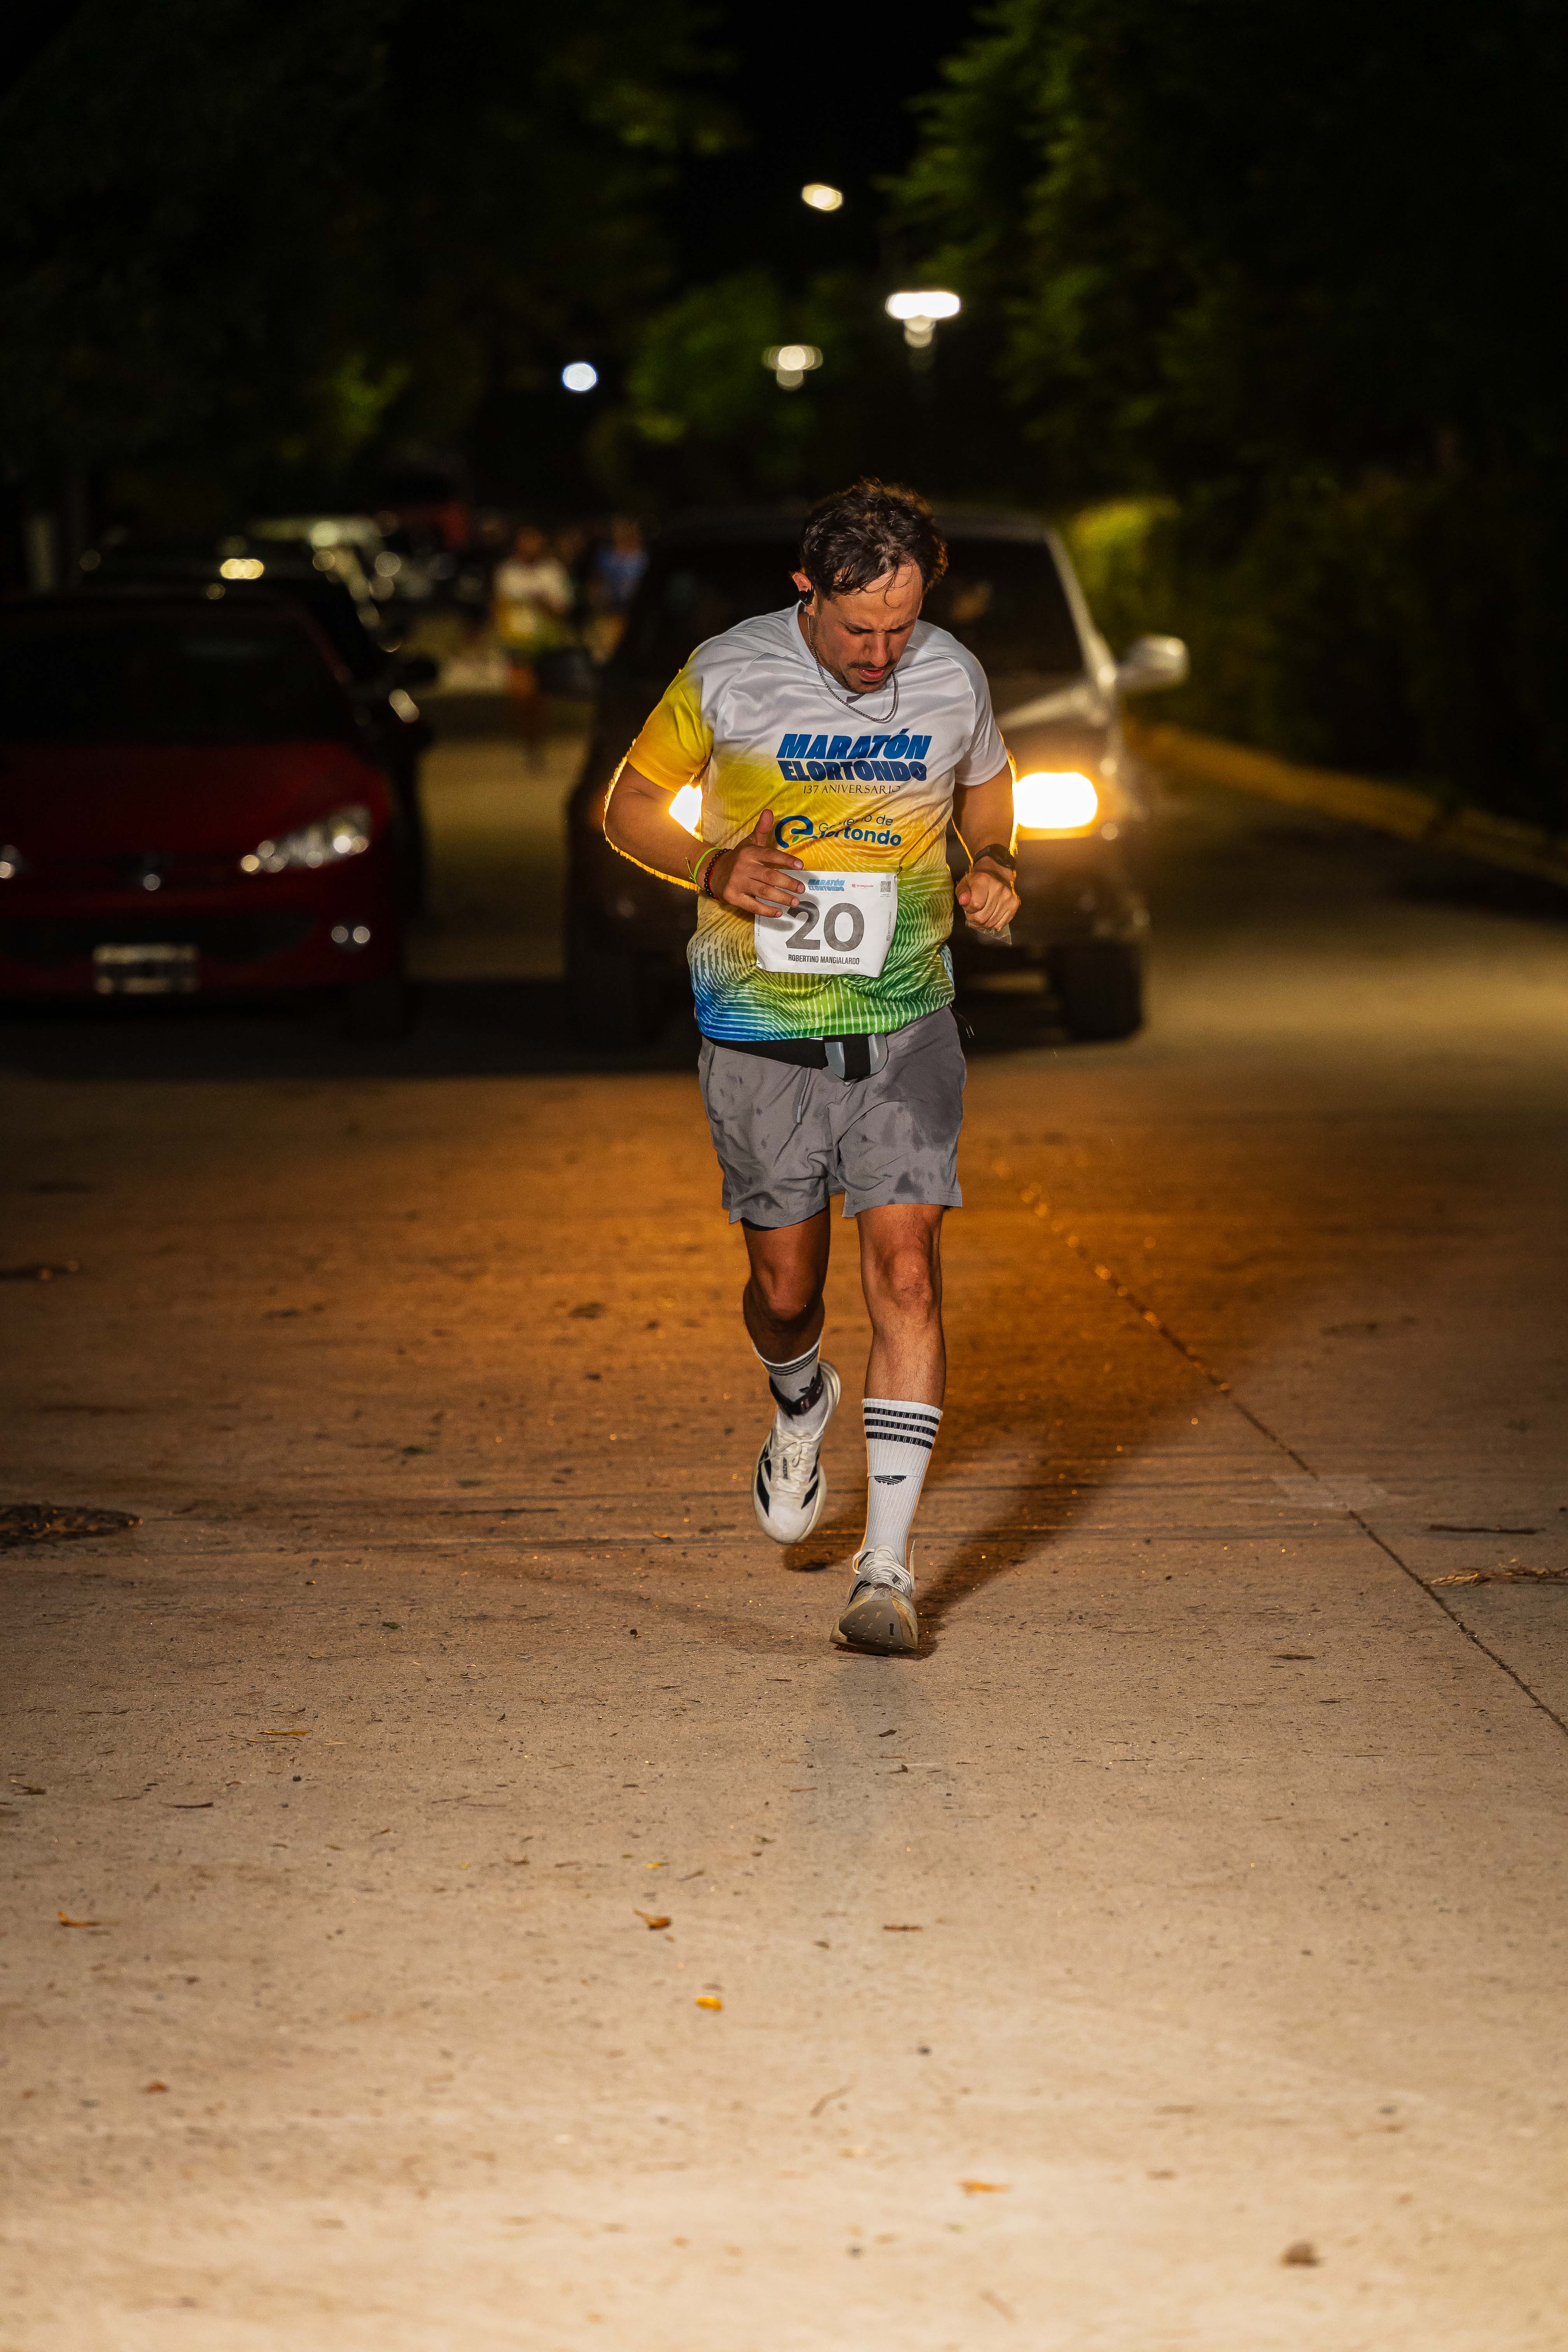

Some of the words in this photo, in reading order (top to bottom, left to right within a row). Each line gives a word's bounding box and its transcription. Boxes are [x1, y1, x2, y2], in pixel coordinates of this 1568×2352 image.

[775, 728, 932, 760] MARATÓN
[777, 760, 927, 782] ELORTONDO
[803, 785, 819, 794] 137
[822, 784, 901, 794] ANIVERSARIO
[876, 815, 893, 826] de
[786, 901, 864, 952] 20
[788, 954, 819, 963] ROBERTINO
[820, 956, 860, 964] MANGIALARDO
